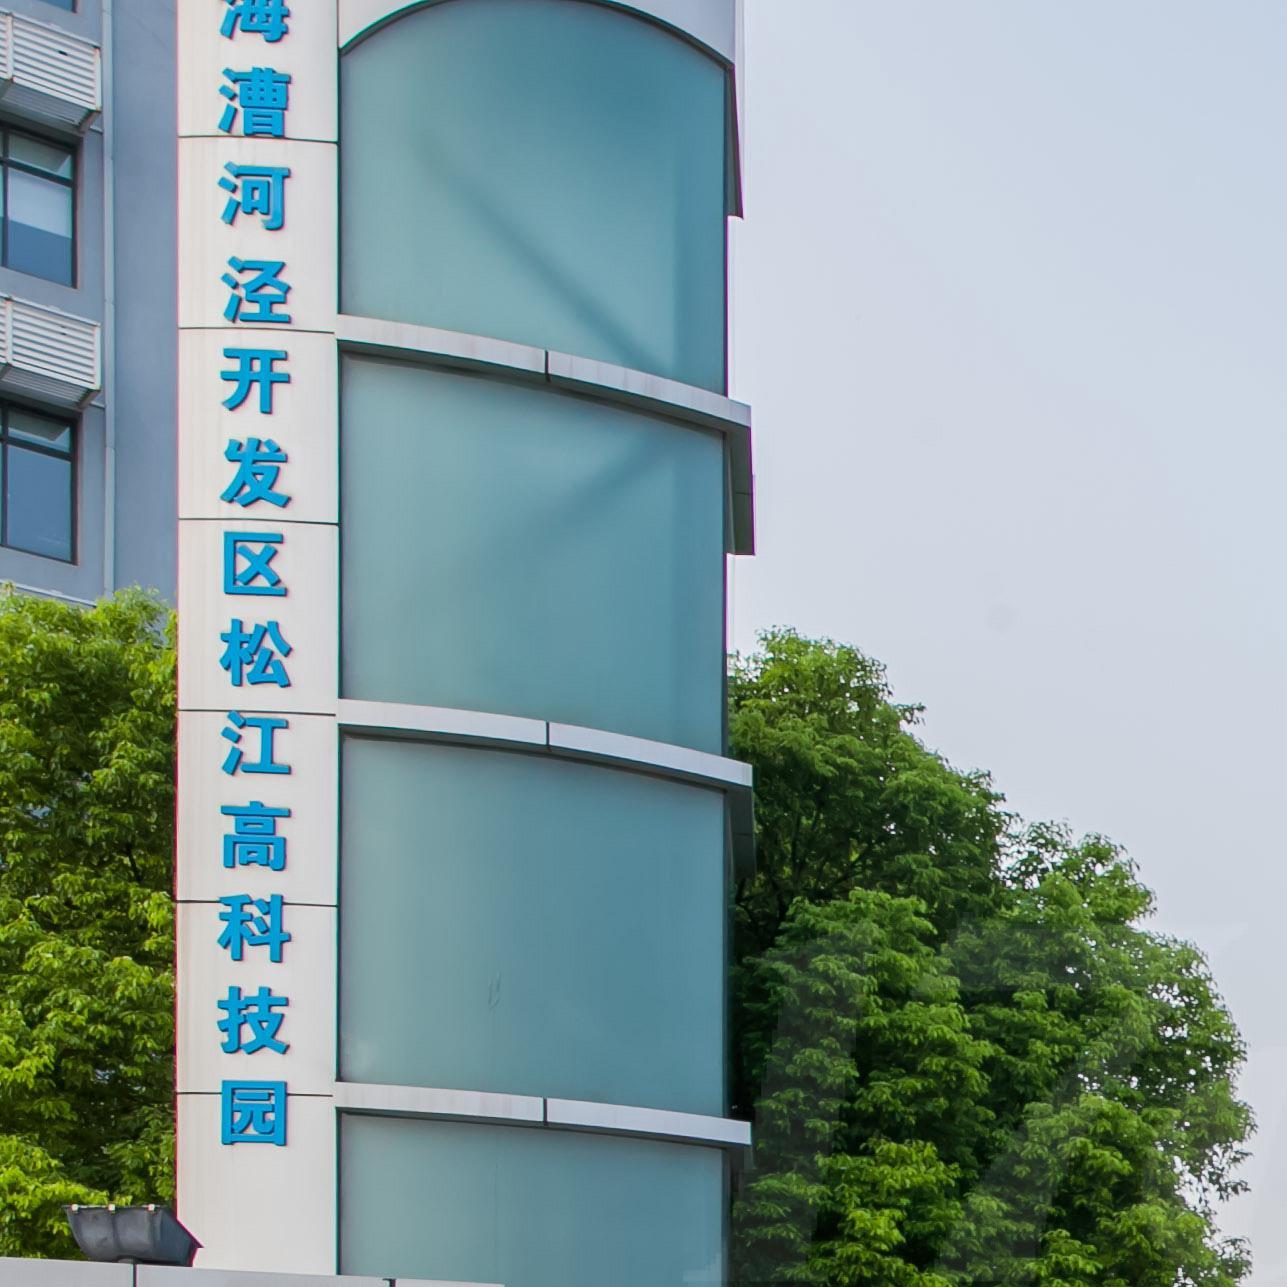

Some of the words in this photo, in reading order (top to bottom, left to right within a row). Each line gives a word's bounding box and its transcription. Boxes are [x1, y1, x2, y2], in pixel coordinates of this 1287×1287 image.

[216, 0, 292, 1147] 海漕河泾开发区松江高科技园
